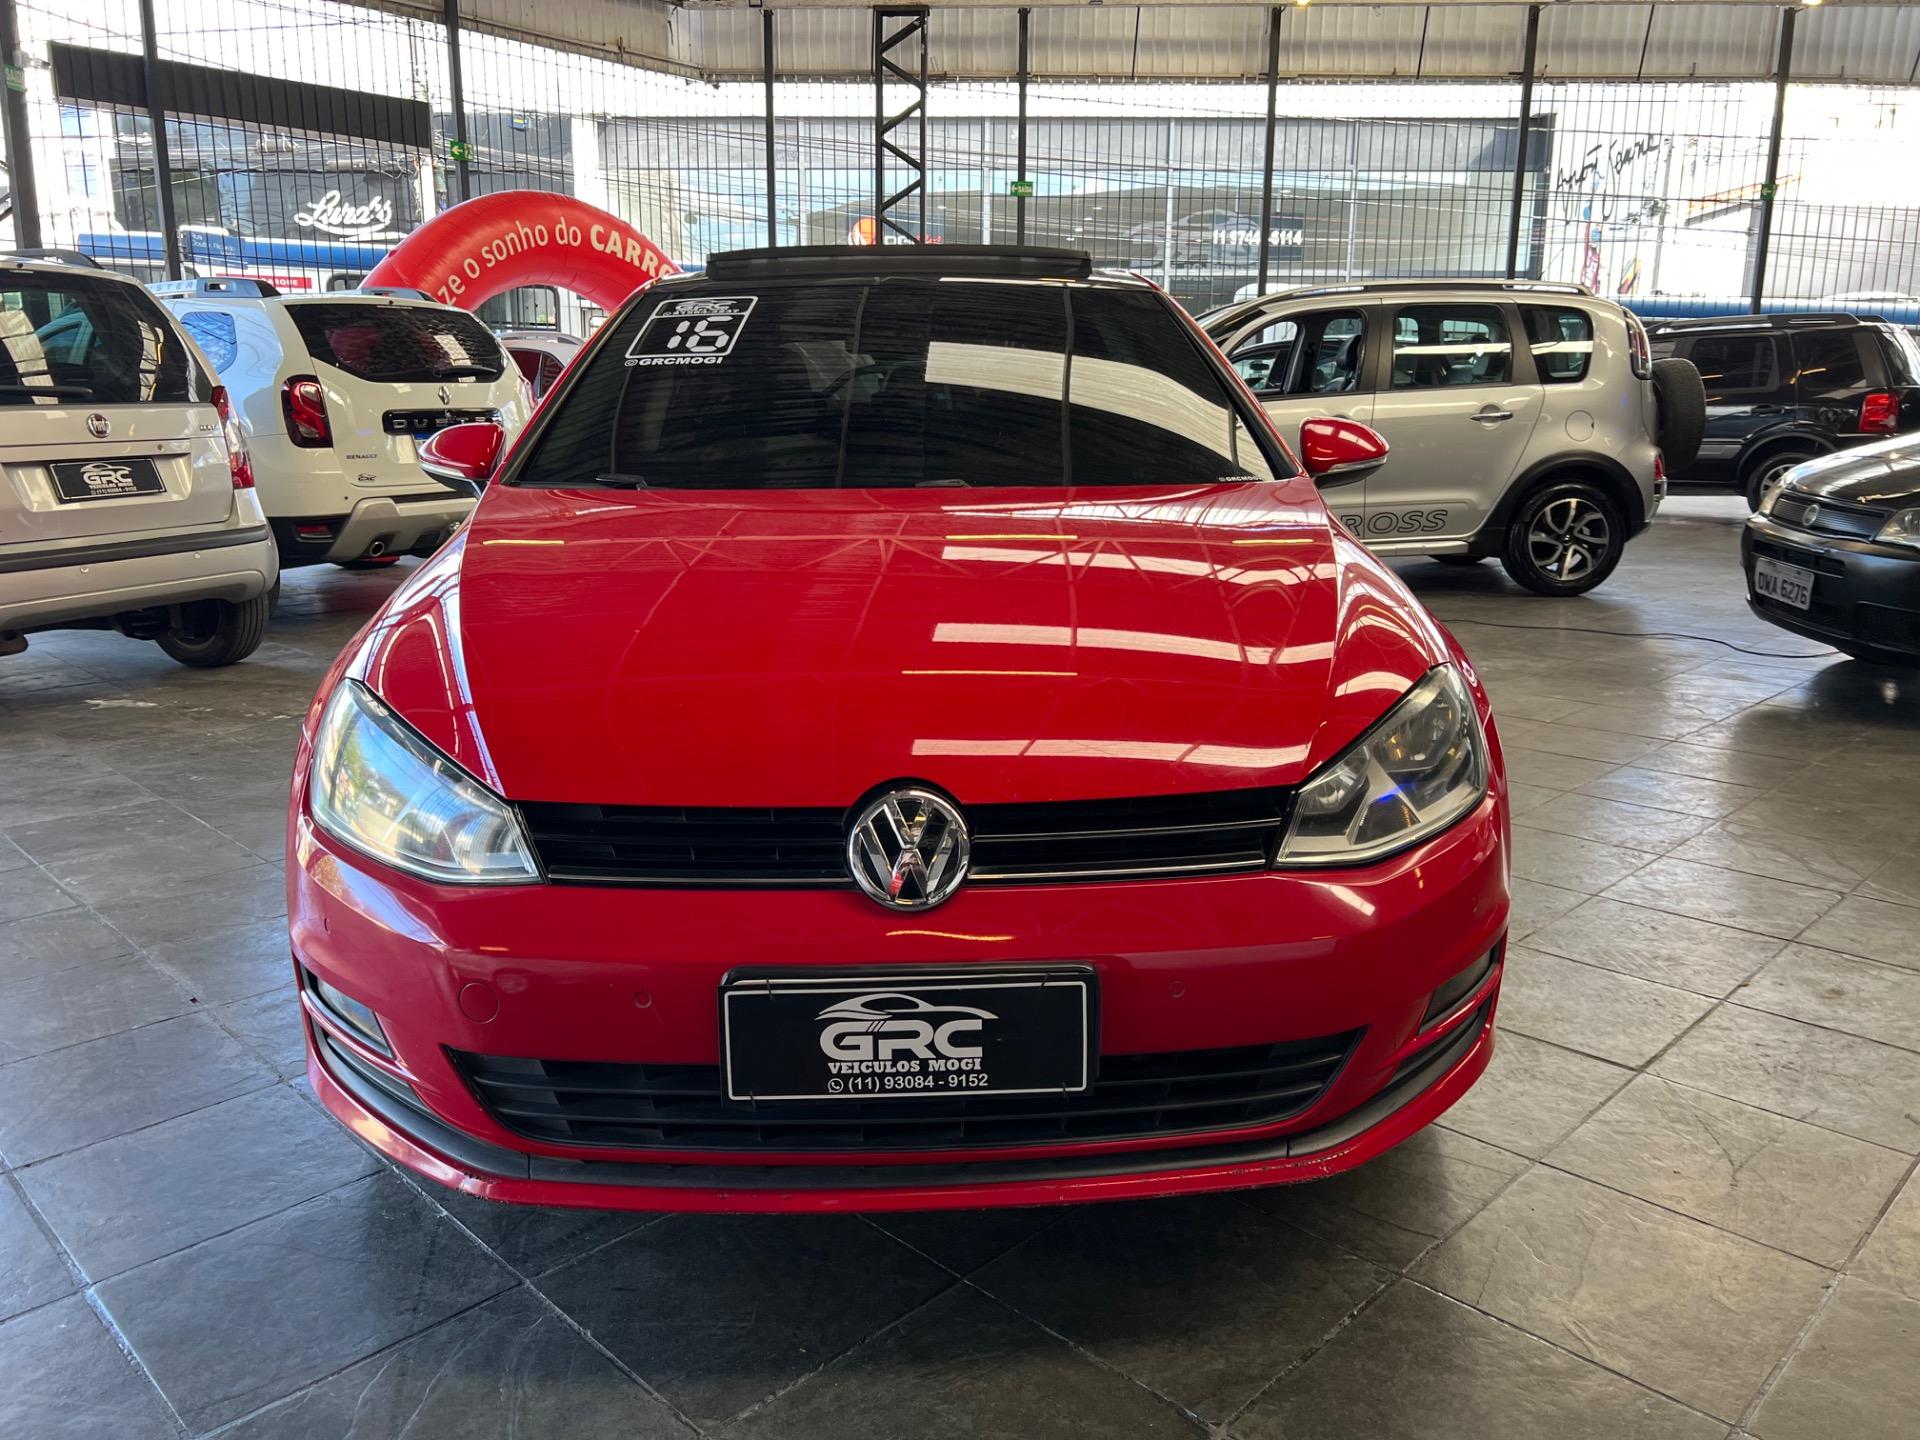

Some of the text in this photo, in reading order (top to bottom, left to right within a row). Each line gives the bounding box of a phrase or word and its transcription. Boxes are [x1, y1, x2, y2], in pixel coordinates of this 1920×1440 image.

[464, 257, 480, 279] o
[482, 219, 549, 268] sonho
[555, 215, 582, 247] do
[1213, 230, 1226, 245] 11
[666, 315, 734, 353] 16
[82, 470, 133, 485] GRC
[819, 1018, 983, 1061] GRC
[828, 1058, 982, 1075] VEICULOS MOGI
[848, 1076, 880, 1093] (11)
[885, 1074, 936, 1089] 93084
[948, 1073, 989, 1088] 9152
